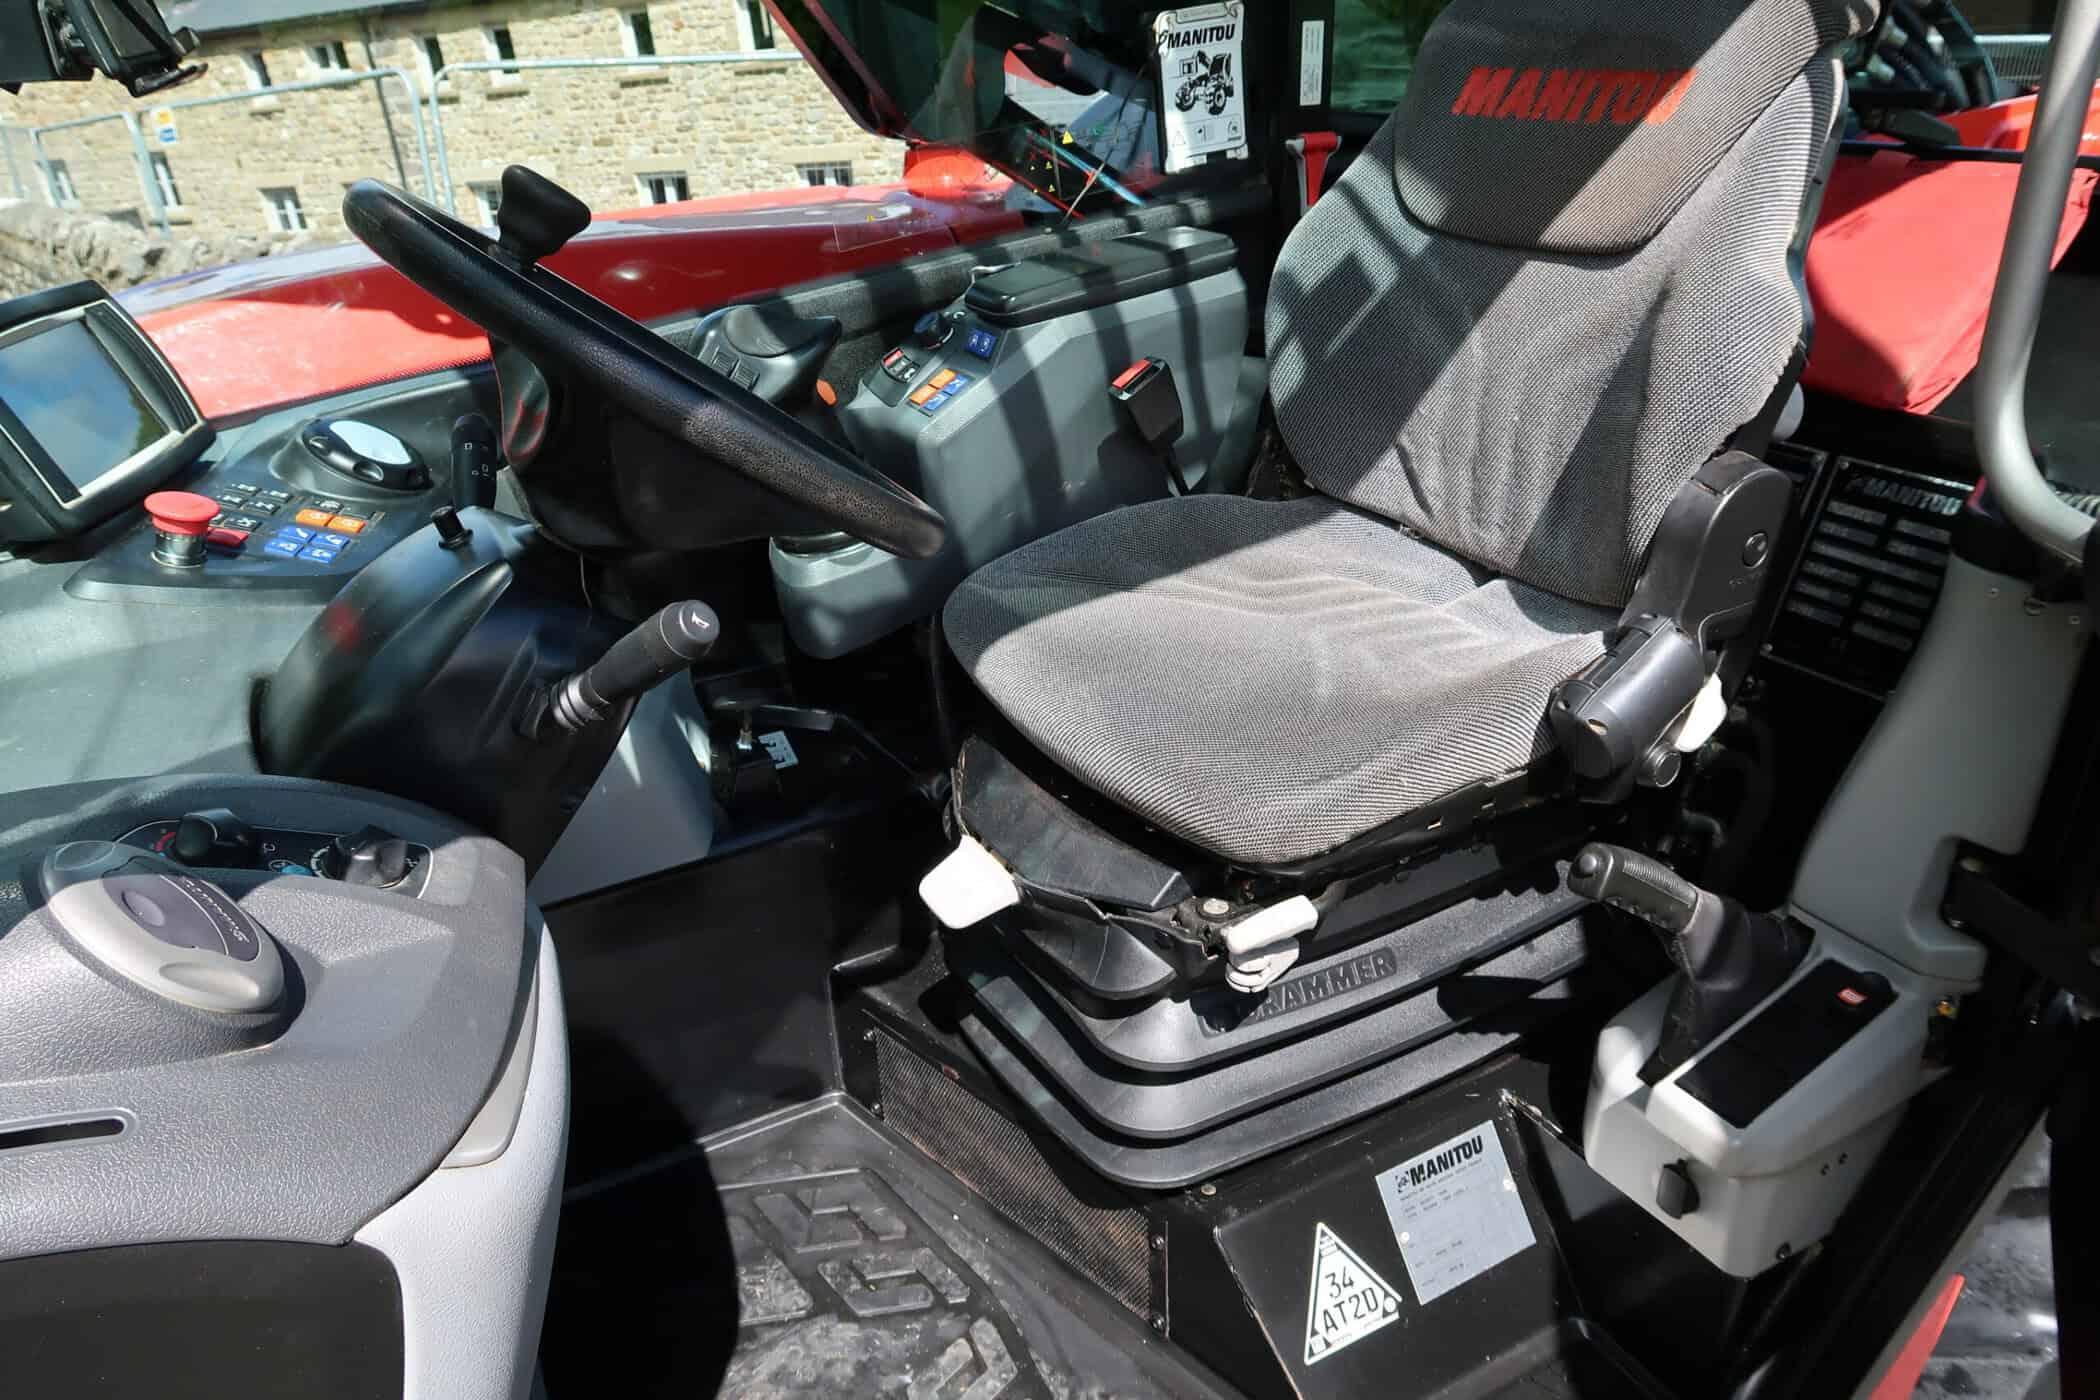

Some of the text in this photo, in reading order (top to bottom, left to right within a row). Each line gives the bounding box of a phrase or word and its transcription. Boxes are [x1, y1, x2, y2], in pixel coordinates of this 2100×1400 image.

[1168, 23, 1235, 49] MANITOU
[1451, 67, 1697, 125] MANITOU
[1251, 954, 1392, 1021] RAMMER
[1409, 1135, 1484, 1187] MANITOU
[1325, 1266, 1354, 1299] 34
[1323, 1287, 1379, 1335] AT2D
